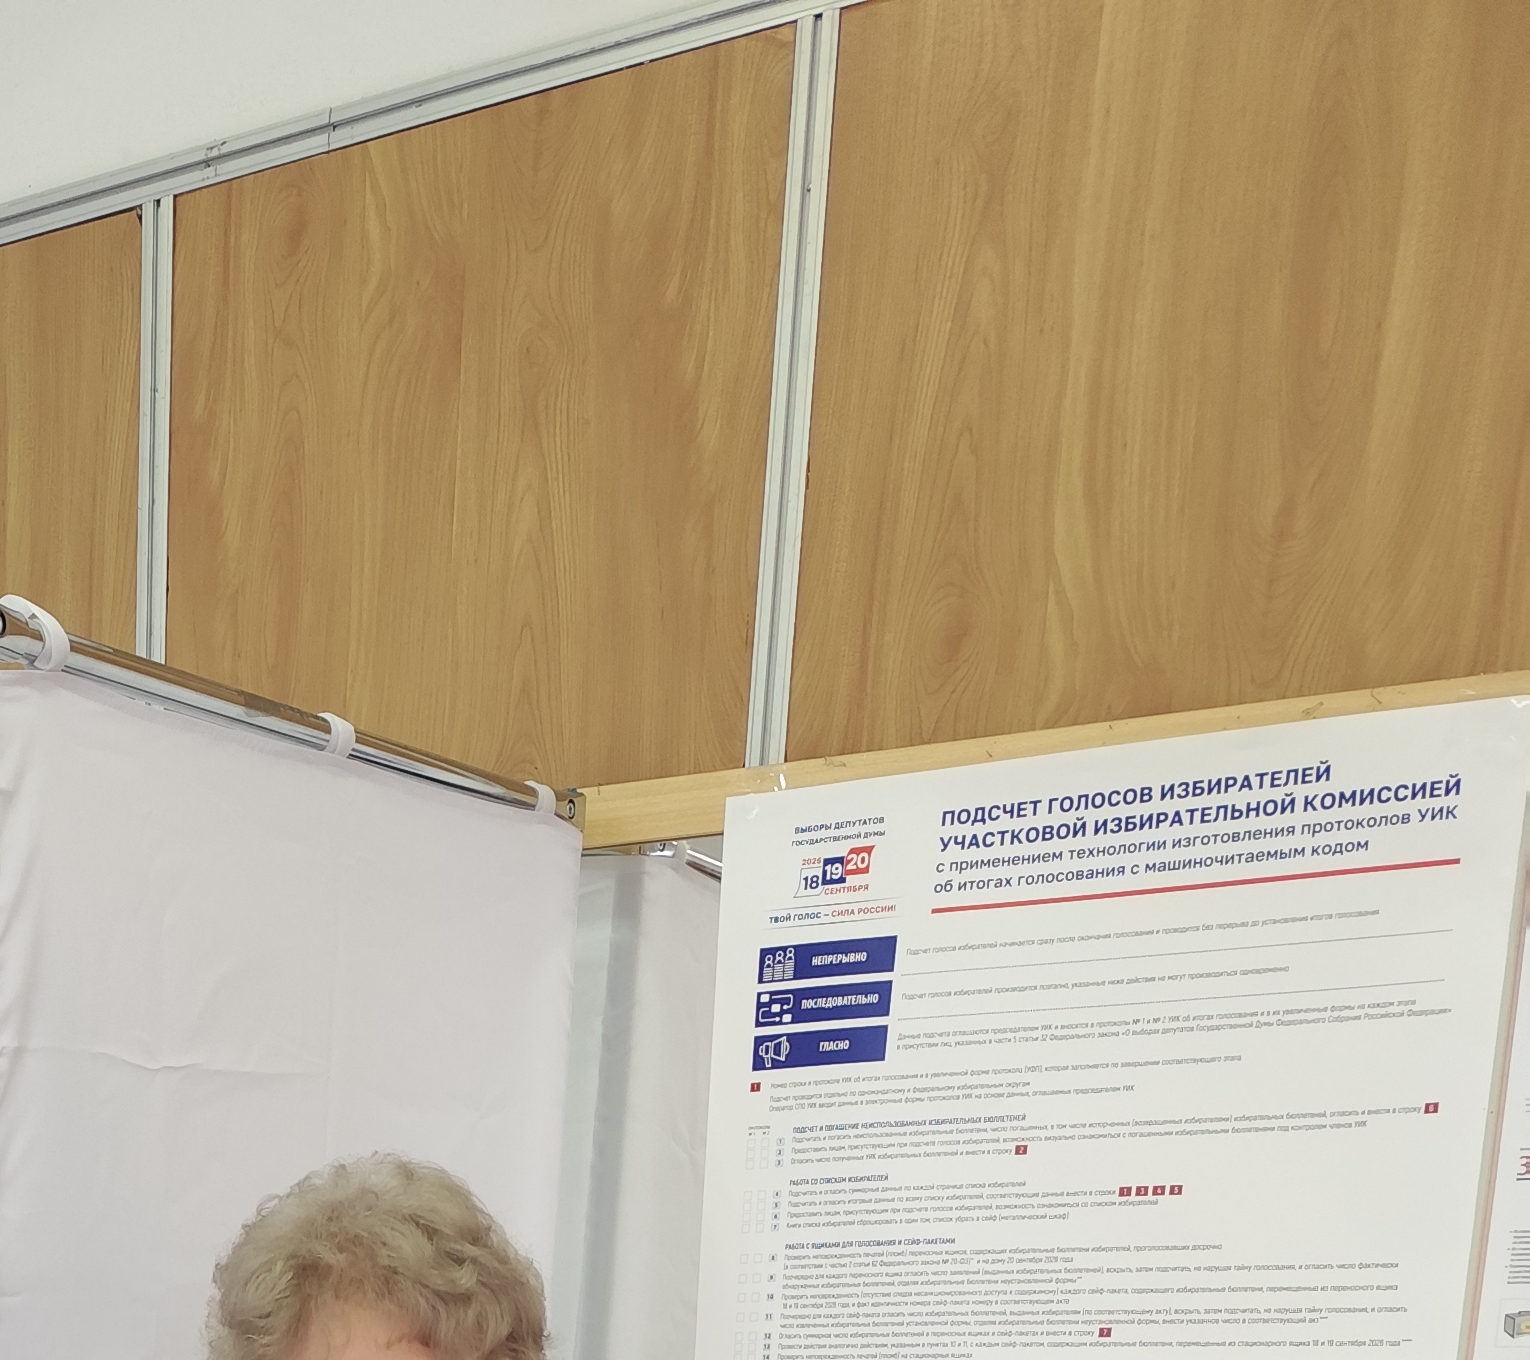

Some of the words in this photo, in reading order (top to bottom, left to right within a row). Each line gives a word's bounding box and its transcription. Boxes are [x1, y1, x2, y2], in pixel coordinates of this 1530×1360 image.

[941, 799, 1042, 827] ПОДСЧЕТ
[1047, 786, 1153, 815] ГОЛОСОВ
[1159, 760, 1331, 801] ИЗБИРАТЕЛЕЙ
[939, 816, 1087, 852] УЧАСТКОВОЙ
[1093, 791, 1296, 836] ИЗБИРАТЕЛЬНОЙ
[1302, 773, 1461, 813] КОМИССИЕЙ
[794, 823, 832, 834] ВЫБОРЫ
[834, 816, 885, 830] ДЕПУТАТОВ
[791, 832, 861, 846] ГОСУДАРСТВЕННОЙ
[863, 830, 886, 839] ДУМЫ
[935, 862, 945, 873] с
[949, 850, 1063, 874] применением
[1067, 839, 1167, 860] технологии
[1171, 825, 1296, 849] изготовления
[1300, 812, 1411, 838] протоколов
[1417, 804, 1458, 823] УИК
[802, 875, 820, 890] 18
[824, 862, 843, 881] 19
[846, 852, 869, 870] 20
[933, 878, 953, 894] об
[957, 876, 1013, 891] итогах
[1017, 865, 1126, 886] голосования
[1130, 863, 1140, 875] с
[1144, 846, 1306, 874] машиночитаемым
[1310, 839, 1369, 857] кодом
[824, 884, 870, 895] СЕНТЯБРЯ
[768, 913, 791, 924] ТВОЙ
[792, 912, 821, 922] ГОЛОС
[831, 908, 855, 918] СИЛА
[857, 904, 896, 915] РОССИИ!
[812, 952, 867, 966] НЕПРЕРЫВНО
[801, 993, 879, 1010] ПОСЛЕДОВАТЕЛЬНО
[819, 1040, 850, 1052] ГЛАСНО
